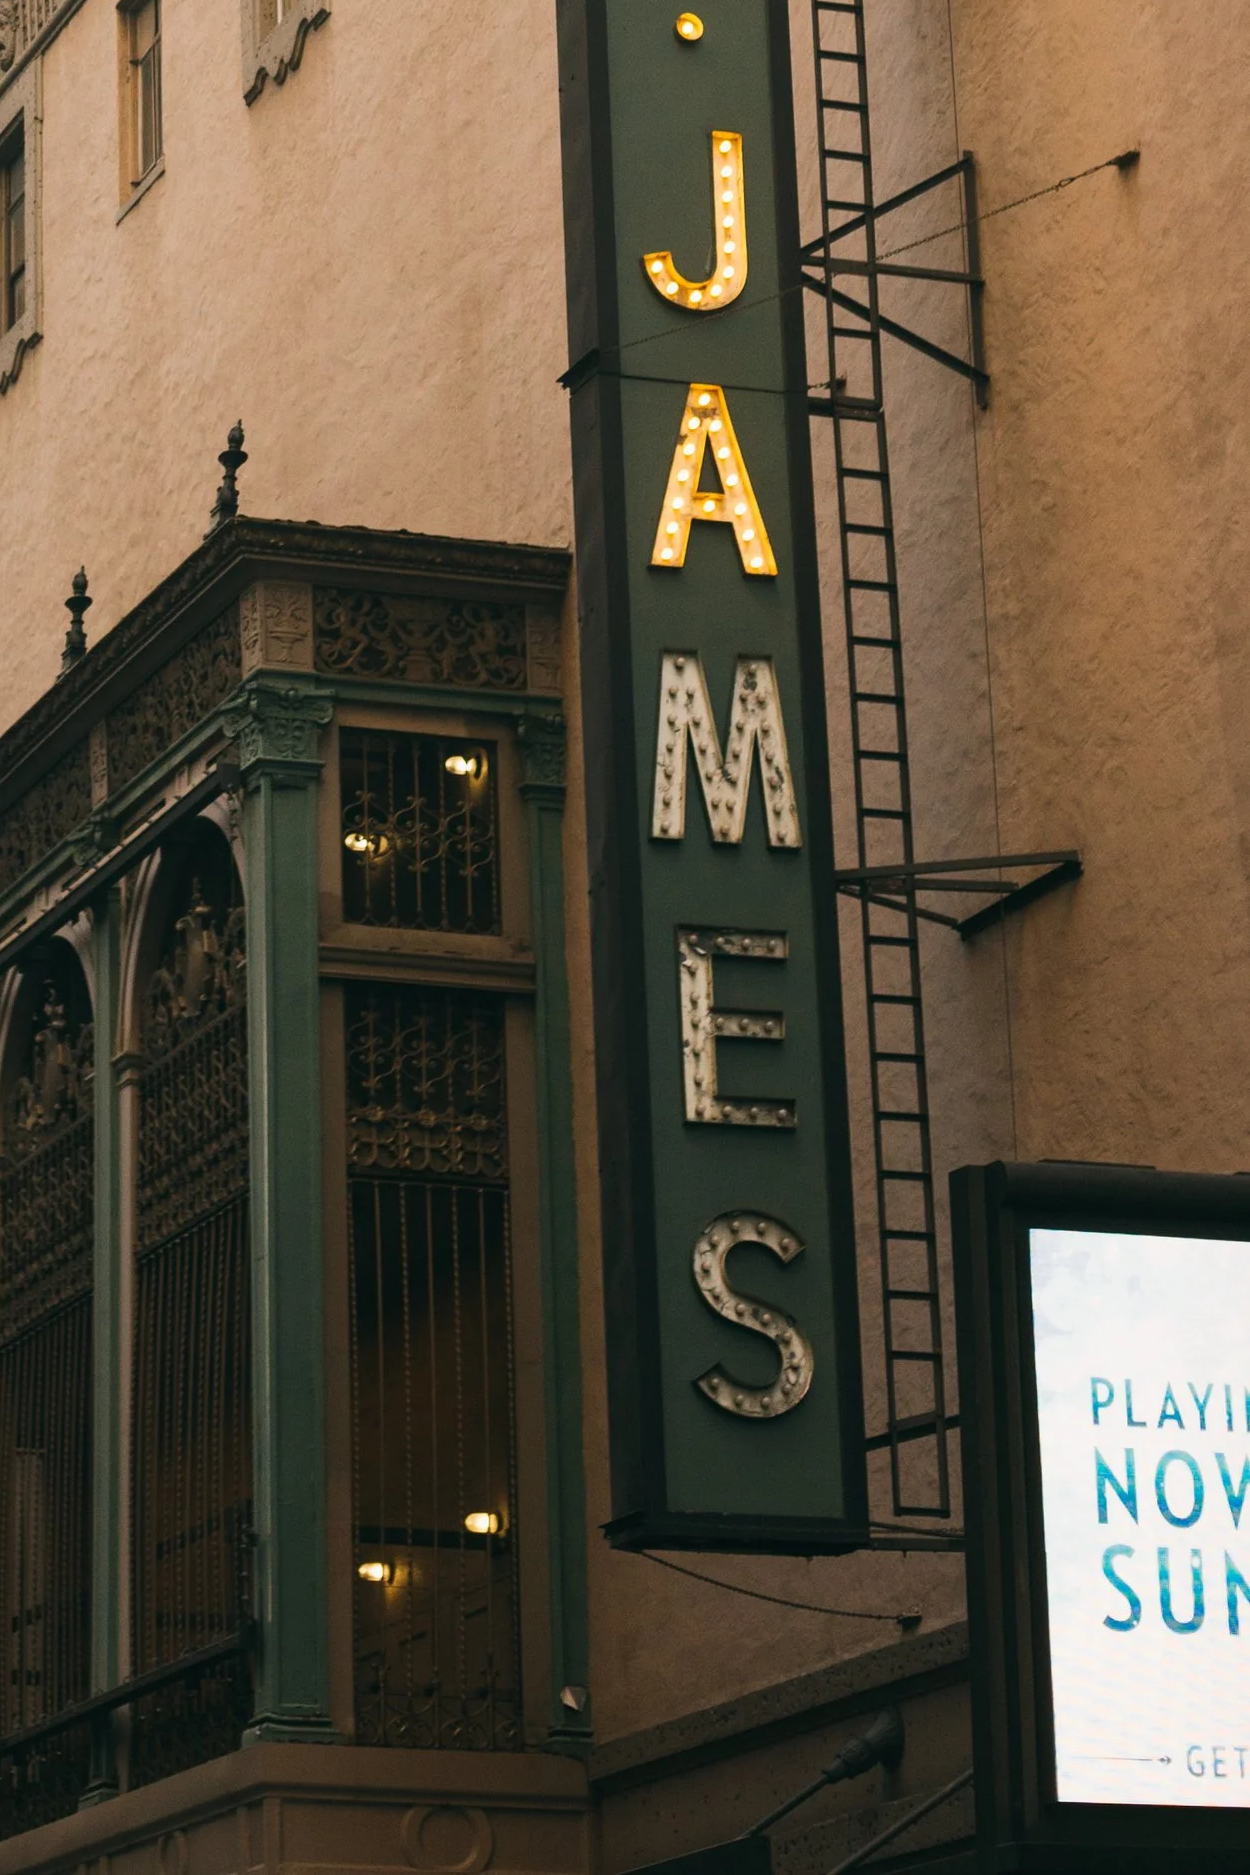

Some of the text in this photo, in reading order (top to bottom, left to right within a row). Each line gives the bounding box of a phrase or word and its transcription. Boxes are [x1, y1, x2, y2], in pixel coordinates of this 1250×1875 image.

[642, 130, 815, 1421] JAMES
[1090, 1376, 1250, 1432] PLAYI
[1186, 1744, 1249, 1779] GET
